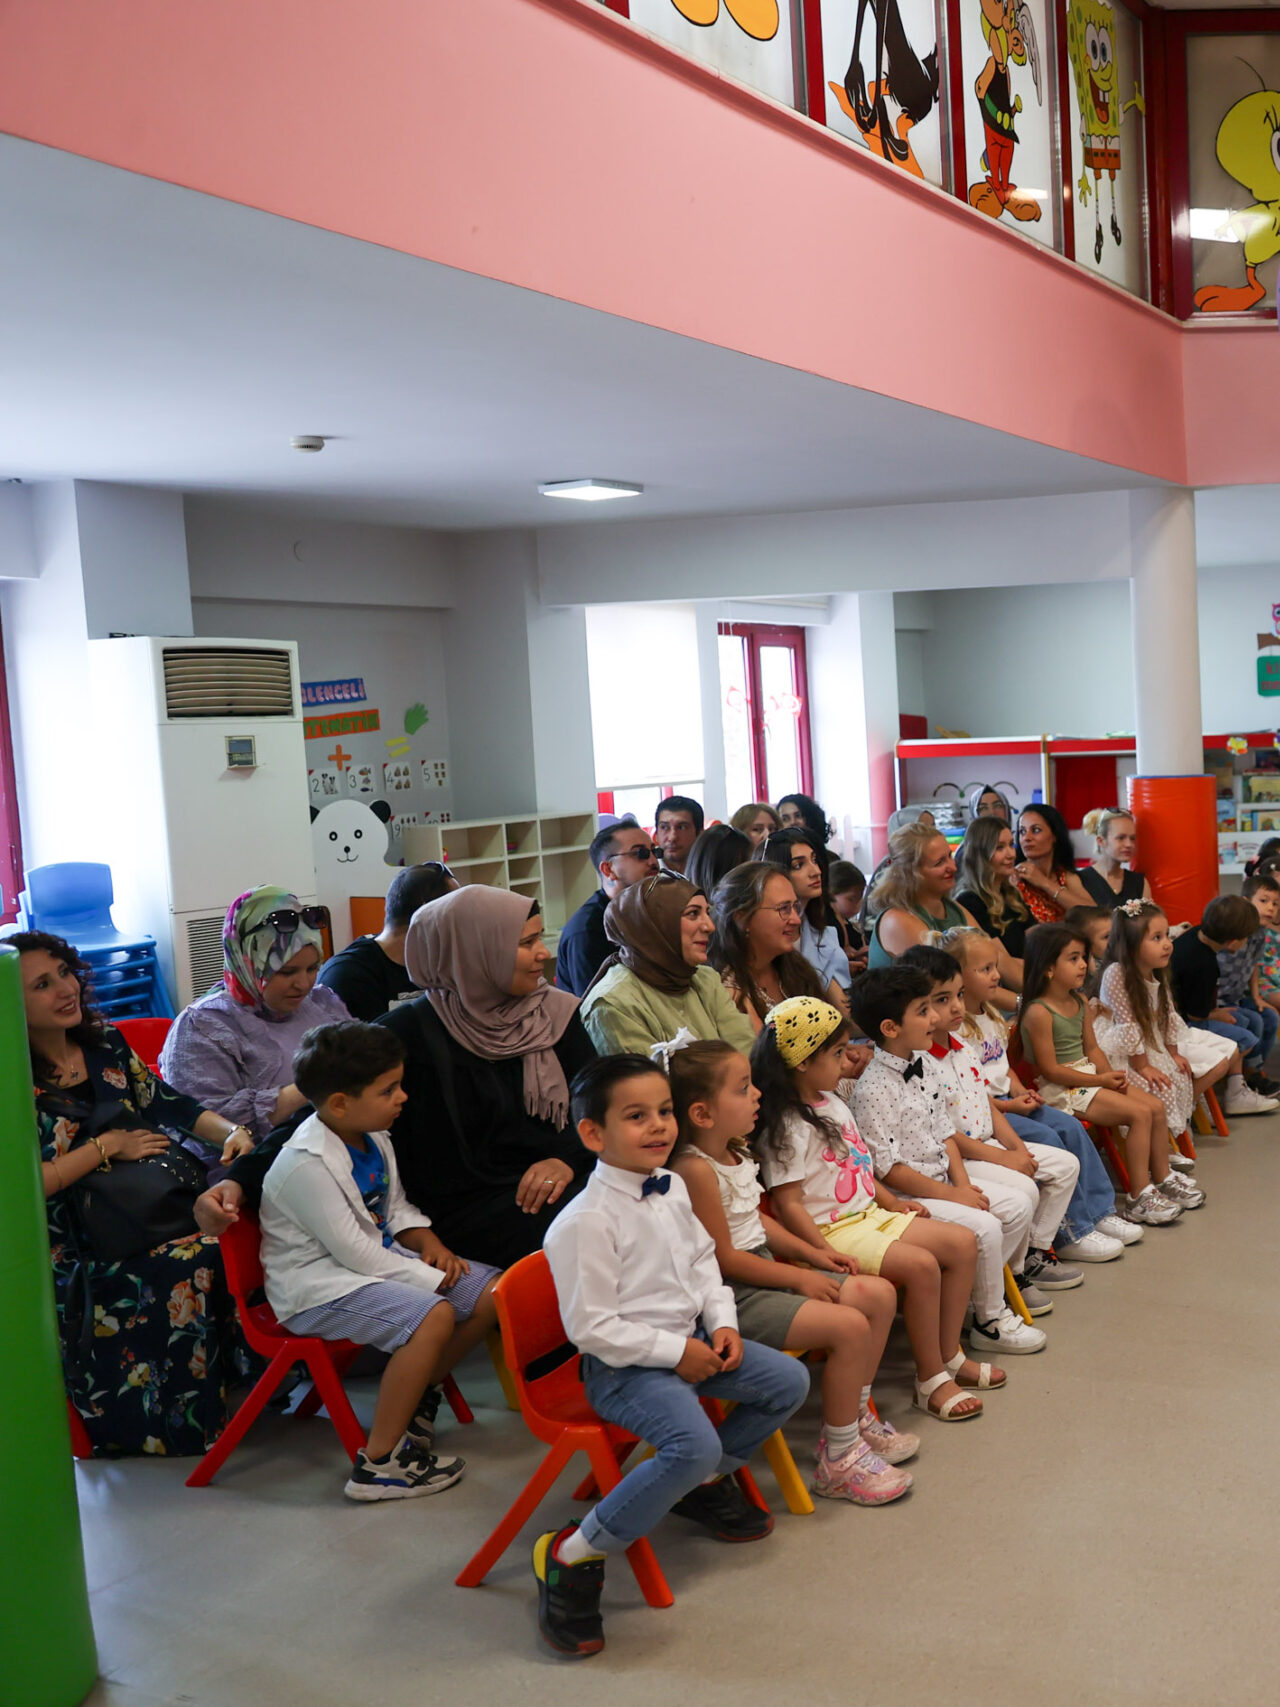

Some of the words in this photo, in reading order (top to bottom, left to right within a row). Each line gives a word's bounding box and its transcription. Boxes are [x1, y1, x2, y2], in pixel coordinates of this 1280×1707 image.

[349, 774, 357, 789] 3
[386, 771, 395, 784] 4
[423, 768, 431, 782] 5
[311, 778, 320, 793] 2
